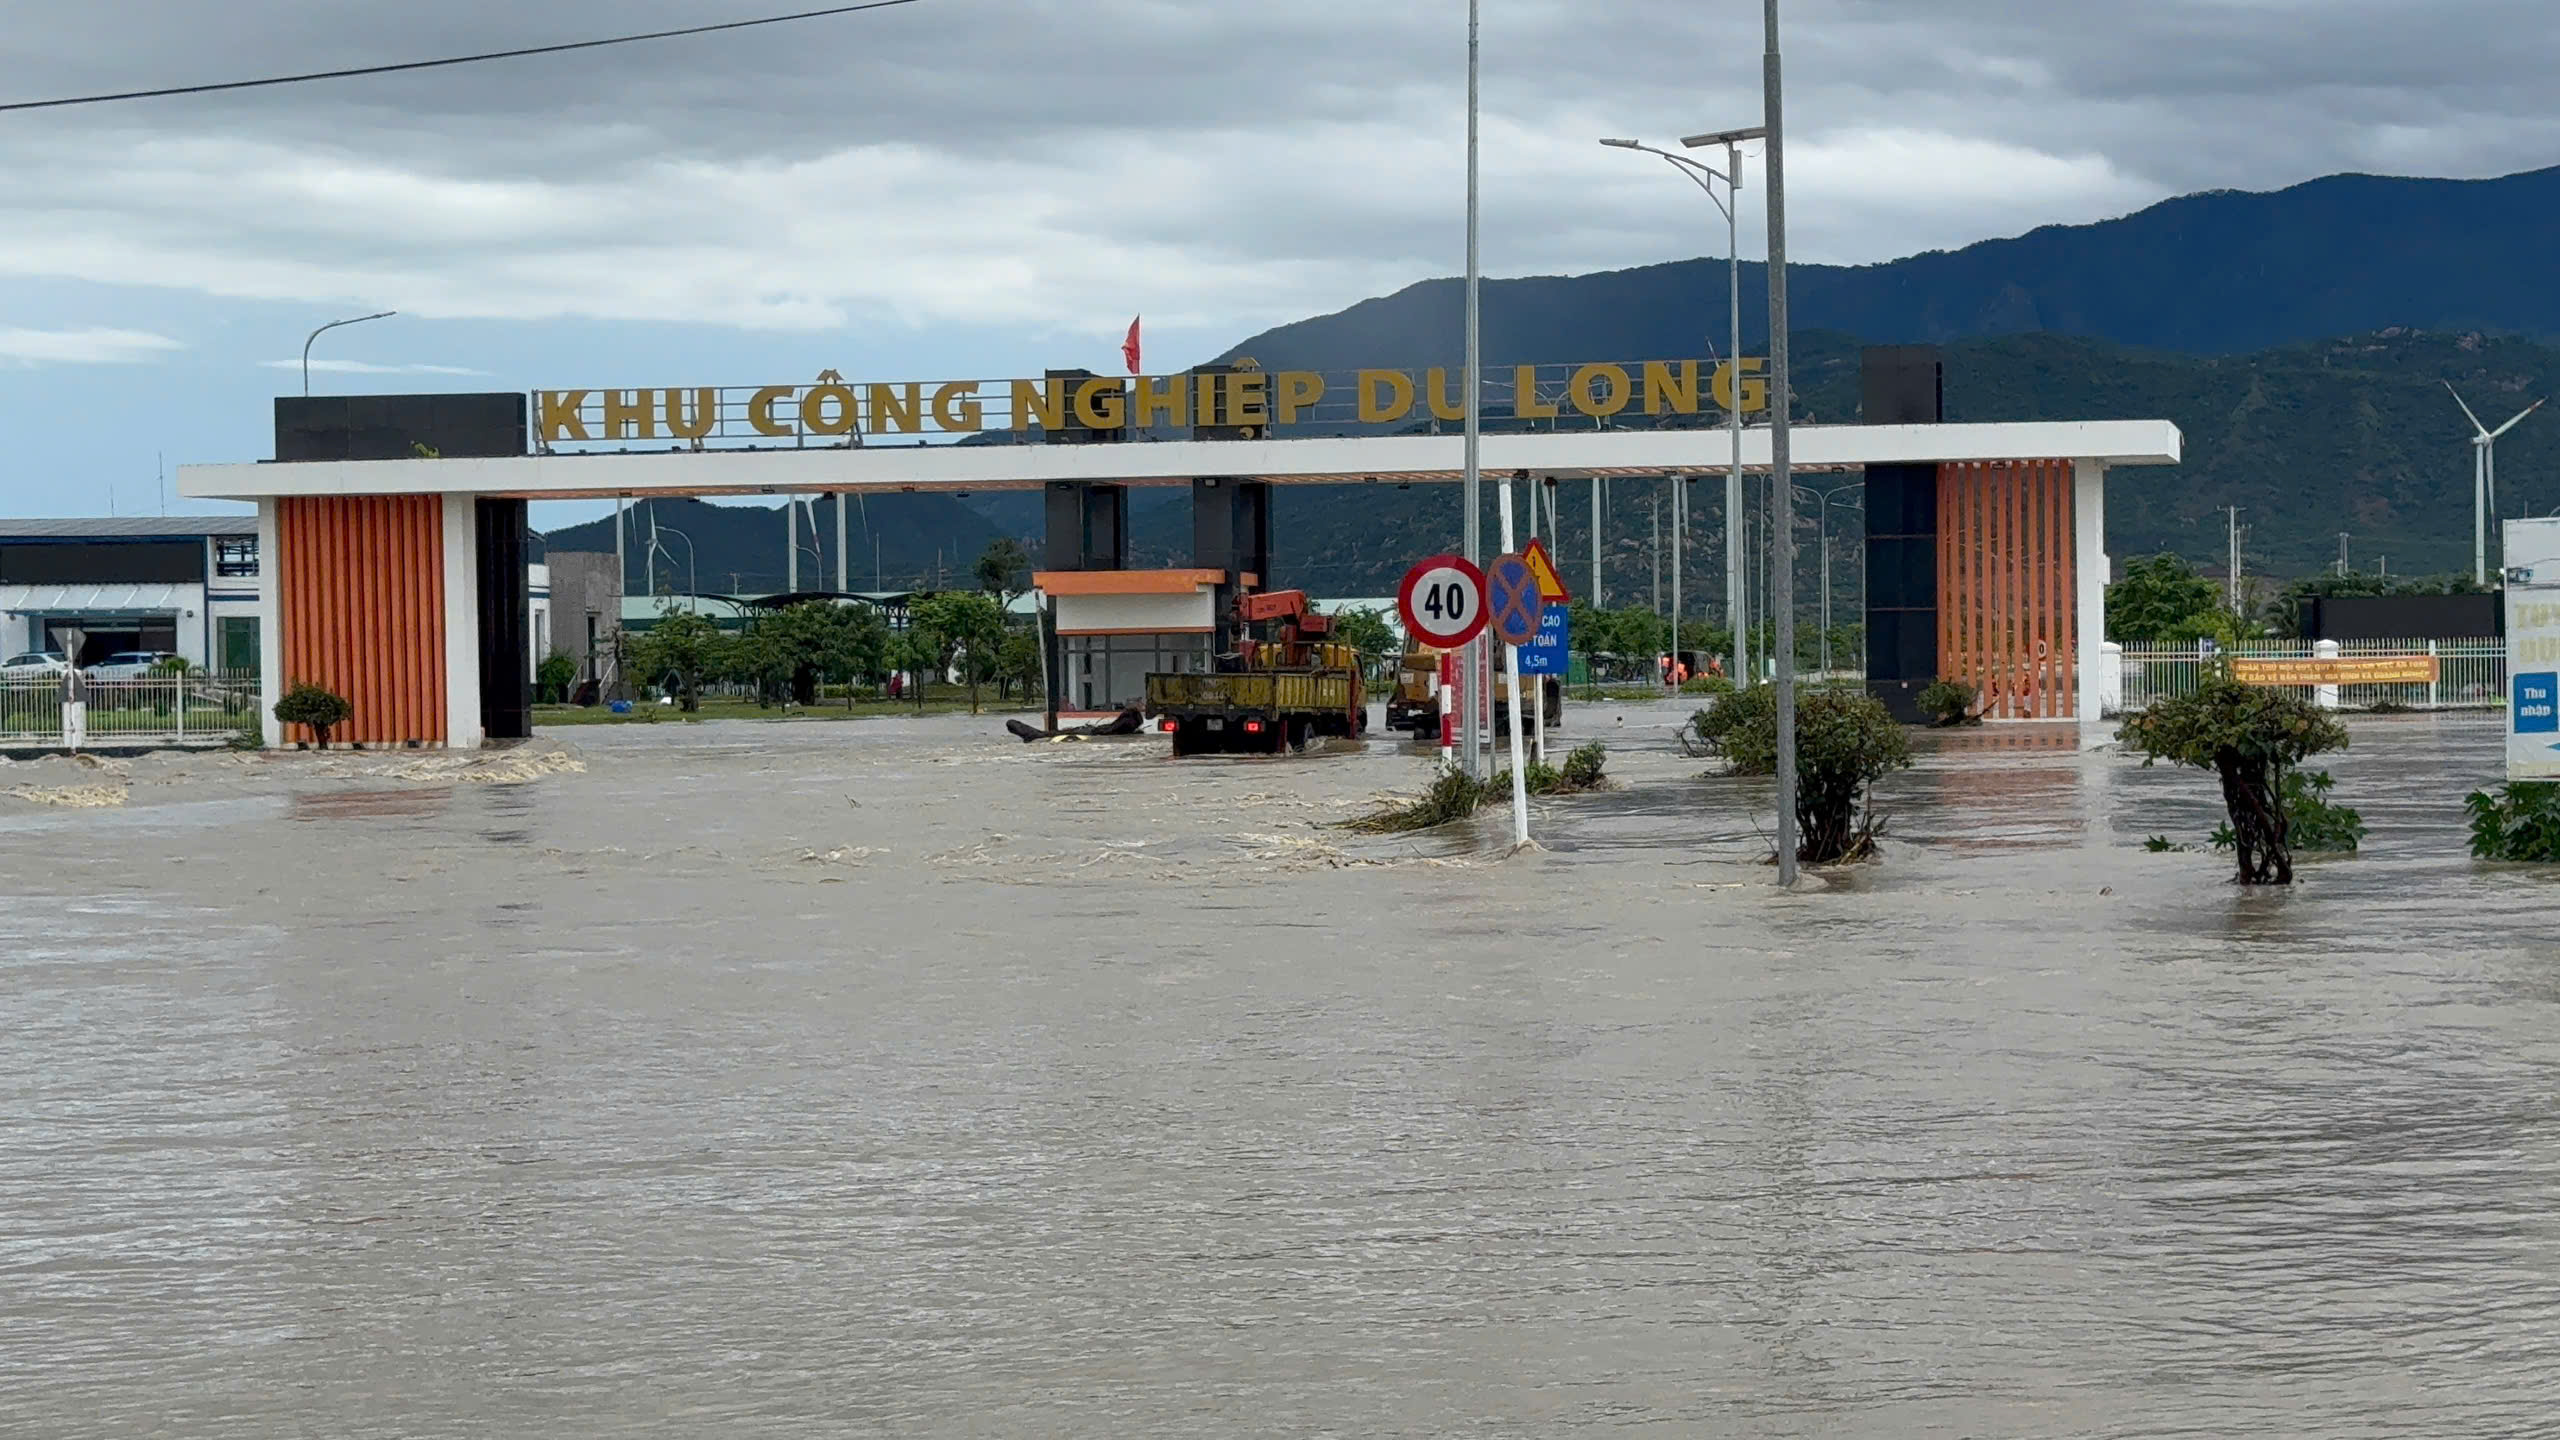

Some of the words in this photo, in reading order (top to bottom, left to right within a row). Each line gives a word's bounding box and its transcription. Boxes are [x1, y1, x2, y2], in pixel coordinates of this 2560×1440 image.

[542, 387, 715, 441] KHU
[748, 369, 982, 436] CÔNG
[1010, 356, 1325, 440] NGHIỆP
[1358, 367, 1467, 424] DU
[1514, 357, 1763, 420] LONG
[1424, 583, 1465, 620] 40
[1541, 614, 1561, 628] CAO
[1524, 654, 1548, 669] 4,5m
[2524, 687, 2547, 699] Thu
[2520, 704, 2551, 717] nhập
